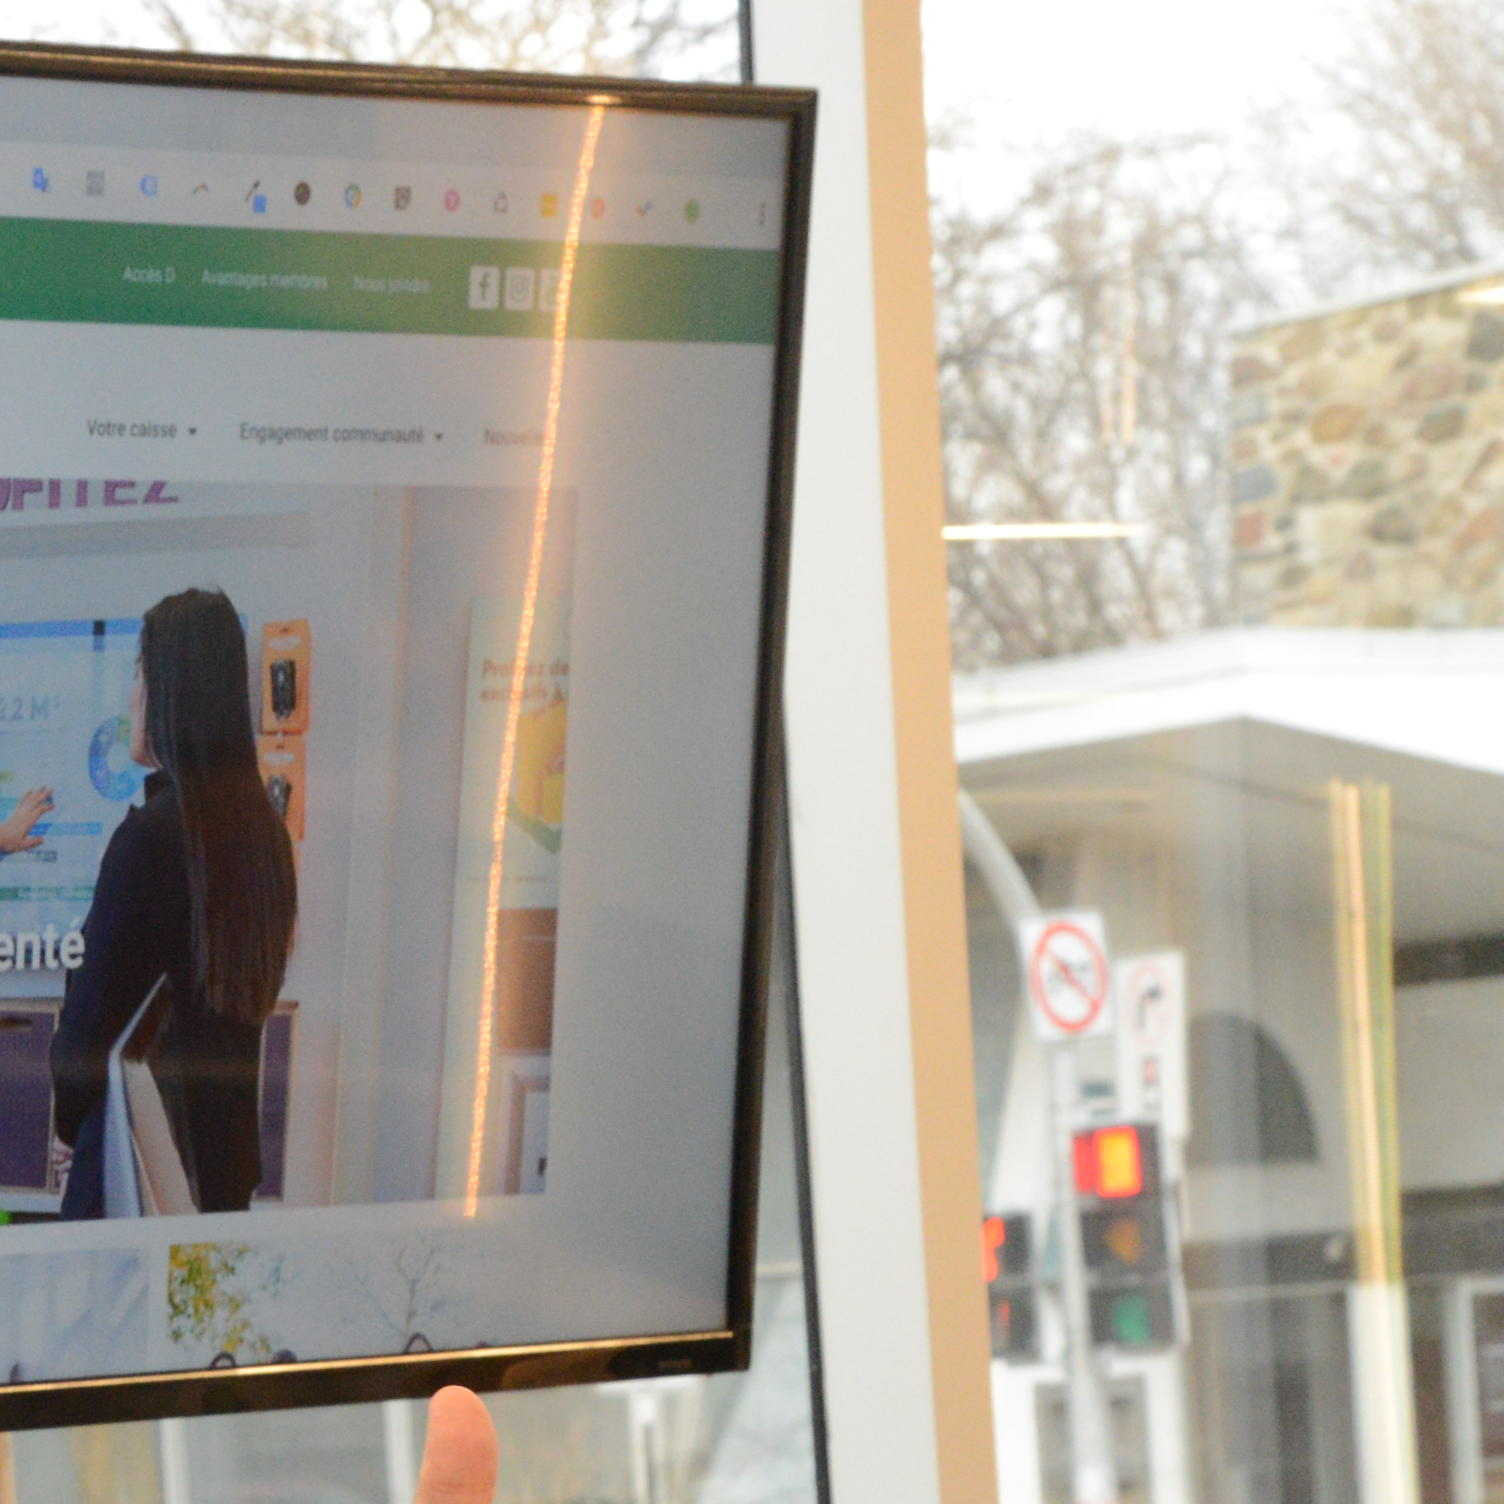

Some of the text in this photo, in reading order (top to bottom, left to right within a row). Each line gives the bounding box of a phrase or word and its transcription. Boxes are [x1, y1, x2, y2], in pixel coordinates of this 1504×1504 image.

[86, 419, 178, 439] Votre caisse
[239, 422, 328, 446] Engagement
